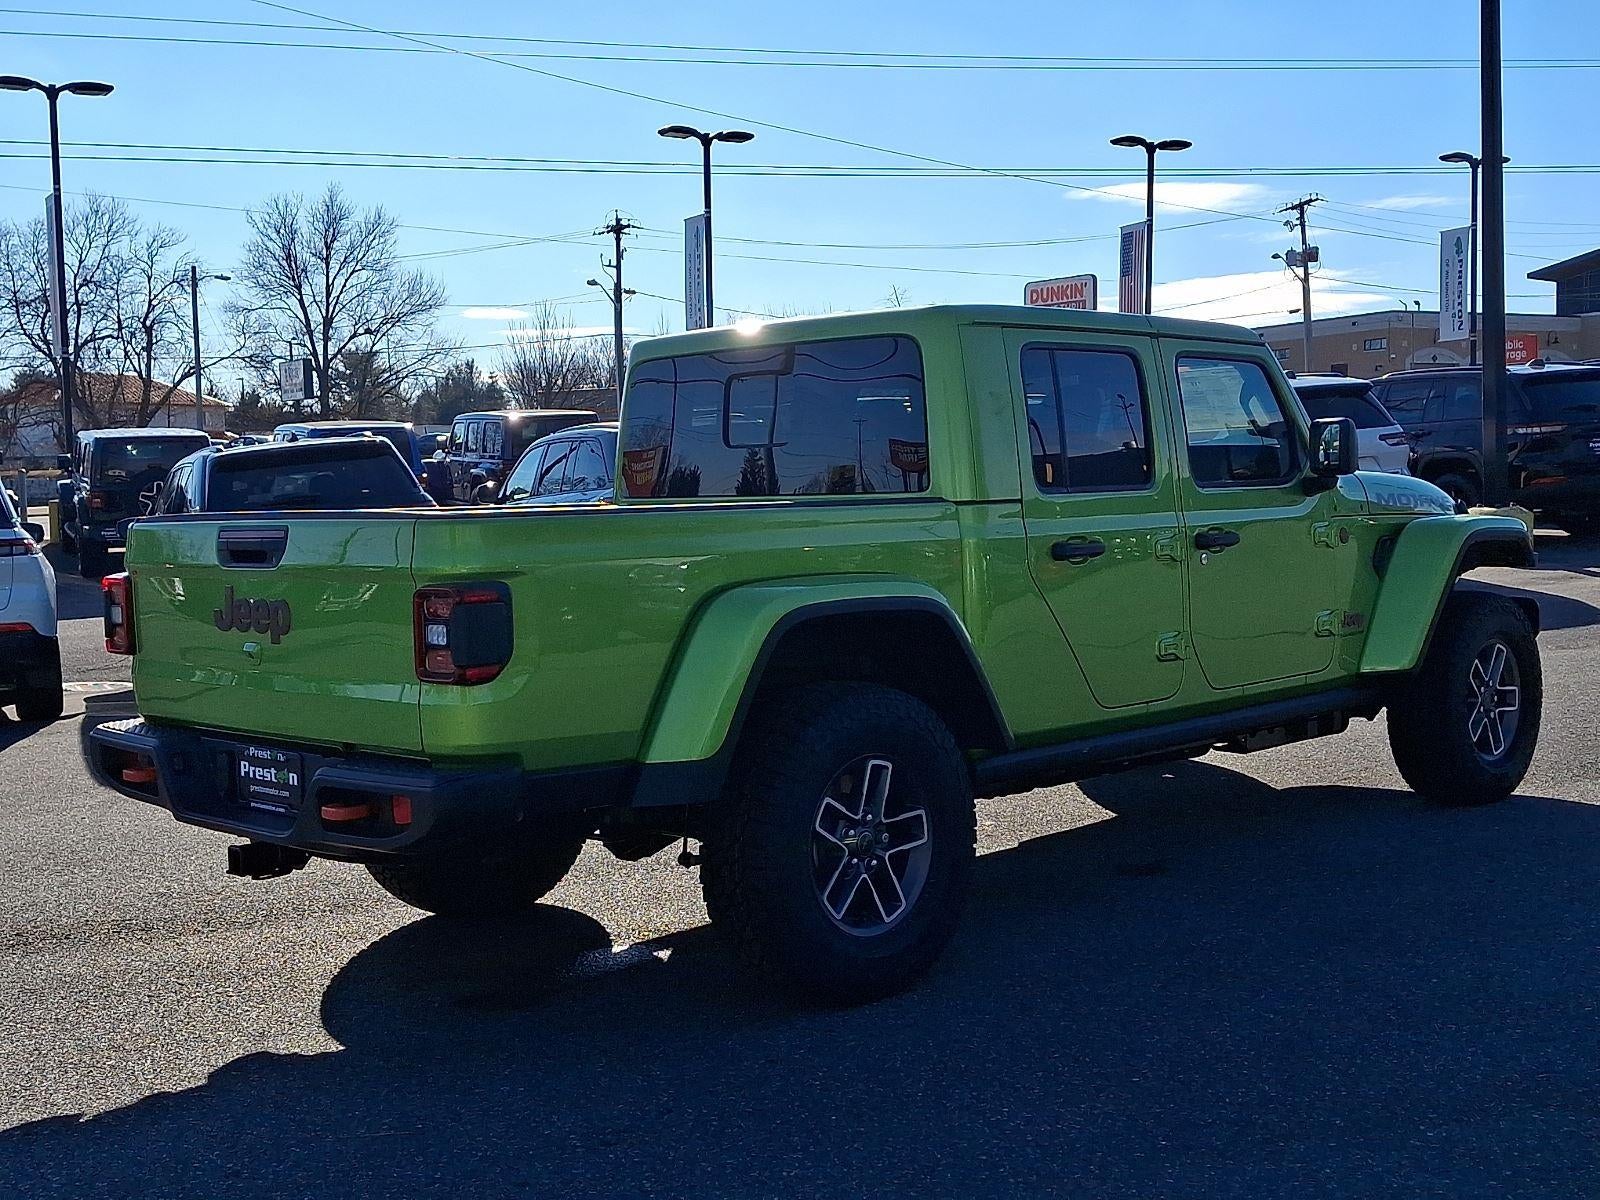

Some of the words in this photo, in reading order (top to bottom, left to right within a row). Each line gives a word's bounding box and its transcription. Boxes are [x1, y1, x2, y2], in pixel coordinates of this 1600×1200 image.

[1444, 258, 1450, 267] OF
[1030, 281, 1088, 304] DUNKIN'
[1505, 339, 1524, 350] blic
[1506, 350, 1527, 361] rage
[213, 585, 292, 645] Jeep
[240, 760, 299, 786] Preston
